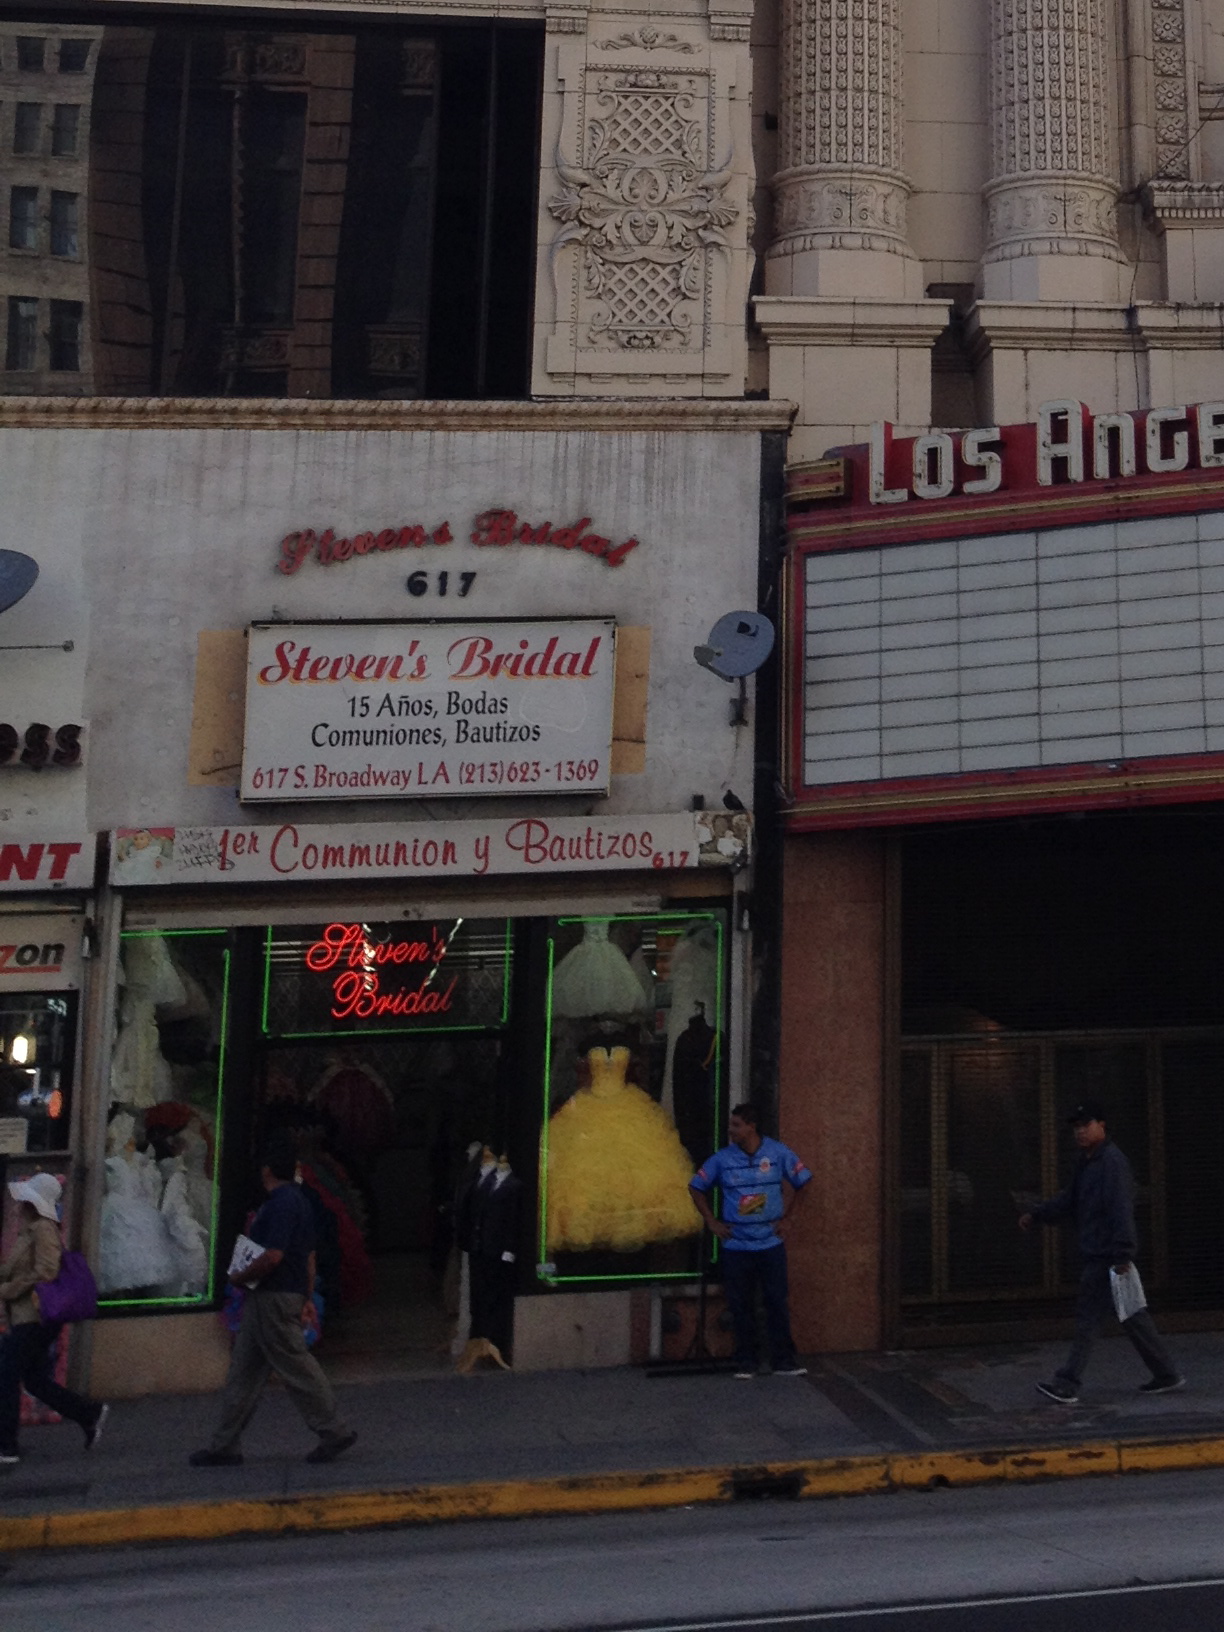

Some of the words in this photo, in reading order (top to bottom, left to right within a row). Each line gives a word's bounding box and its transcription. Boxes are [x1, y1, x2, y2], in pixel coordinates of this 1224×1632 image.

[869, 420, 1002, 505] LOS
[470, 507, 640, 567] Bridal
[407, 571, 477, 597] 617
[256, 639, 432, 686] Steven's
[447, 635, 602, 682] Bridal
[347, 695, 370, 718] 15
[377, 692, 438, 719] Años,
[446, 691, 508, 716] Bodas
[311, 722, 447, 747] Comuniones,
[455, 719, 541, 744] Bautizos
[252, 766, 289, 790] 617
[294, 765, 308, 788] S.
[313, 764, 412, 791] Broadway
[218, 828, 260, 870] 1er
[270, 824, 457, 873] Communion
[473, 835, 491, 874] y
[505, 819, 655, 864] Bautizos
[652, 851, 690, 869] 617
[331, 971, 460, 1018] Bridal
